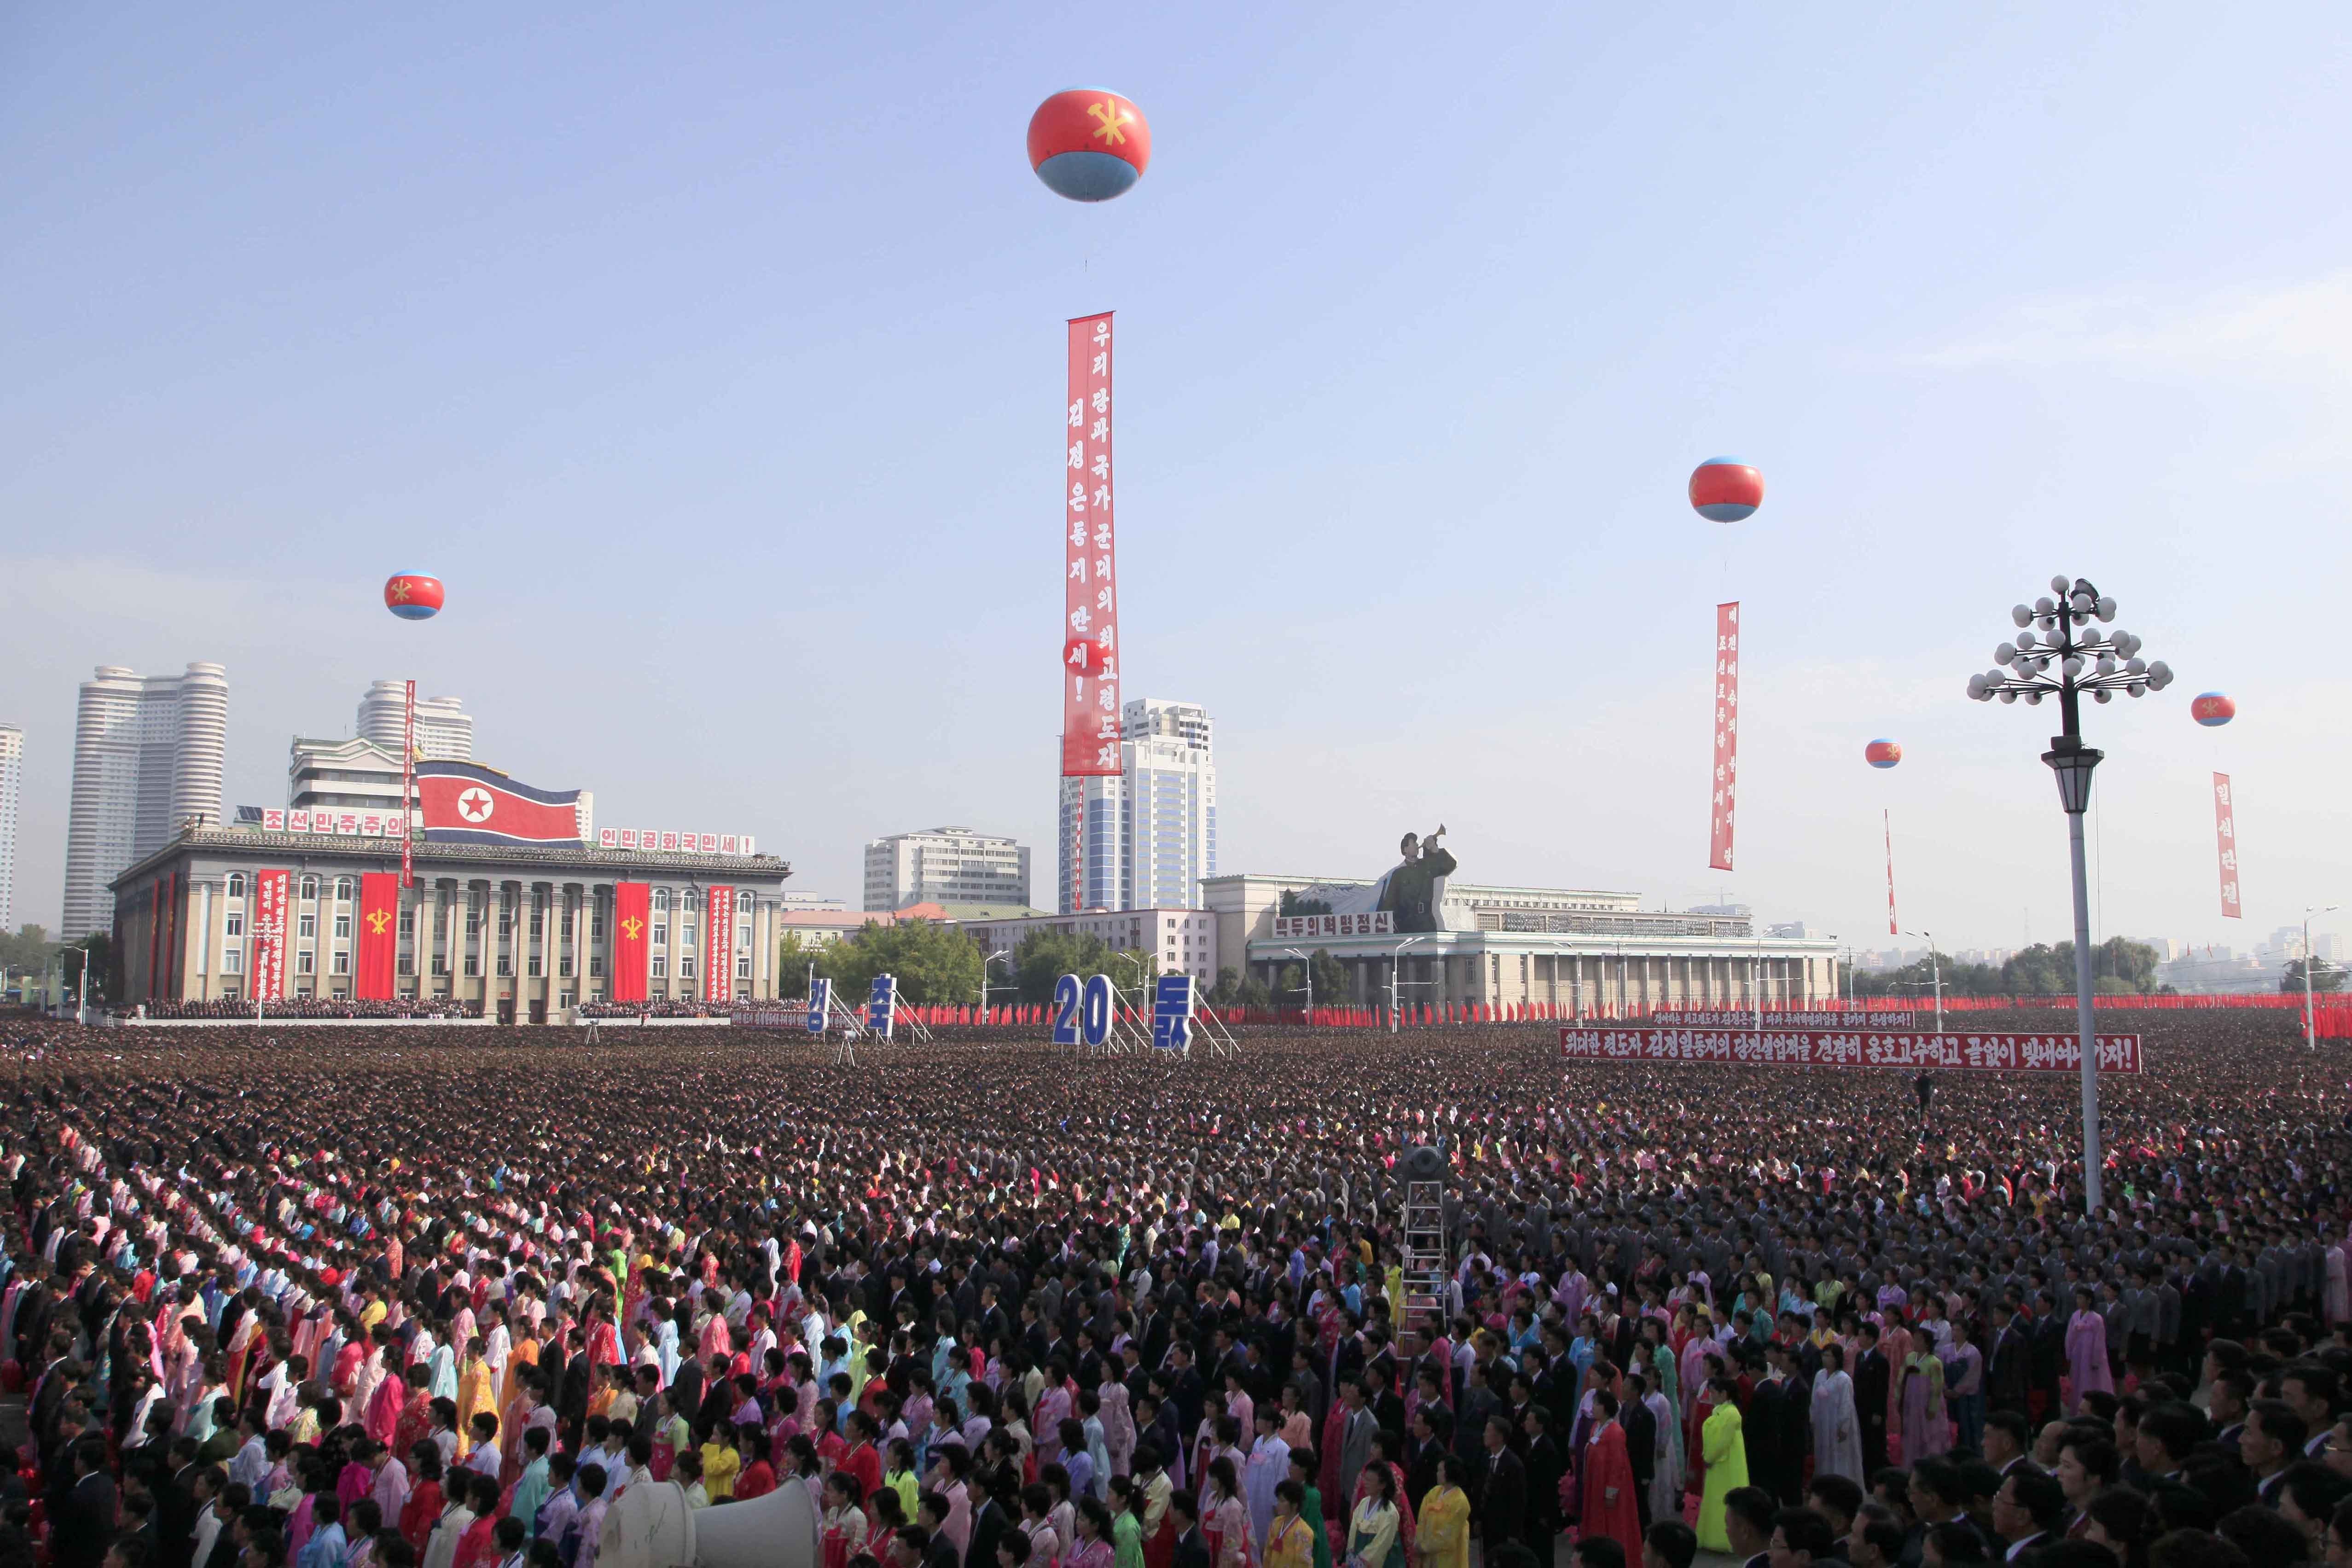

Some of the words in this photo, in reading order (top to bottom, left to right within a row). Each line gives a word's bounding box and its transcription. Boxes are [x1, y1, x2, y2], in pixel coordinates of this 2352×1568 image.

[1092, 322, 1110, 377] 우리
[1091, 388, 1109, 442] 당과
[1068, 398, 1087, 584] 김정은동지
[1091, 454, 1111, 511] 국가
[1093, 523, 1113, 613] 군대의
[1068, 605, 1091, 702] 만세!
[1097, 625, 1119, 769] 최고령도자
[266, 810, 403, 836] 조선민주주의
[2217, 783, 2238, 905] 일심단결
[1720, 1011, 1763, 1025] 김정은
[1566, 1031, 1600, 1055] 위대한
[1603, 1031, 1642, 1057] 령도자
[1645, 1030, 1730, 1059] 김정일동지의
[1733, 1033, 1811, 1061] 당건설업적을
[1814, 1034, 1861, 1063] 견결히
[1865, 1035, 1963, 1065] 옹호고수하고
[1964, 1037, 2016, 1067] 끝없이
